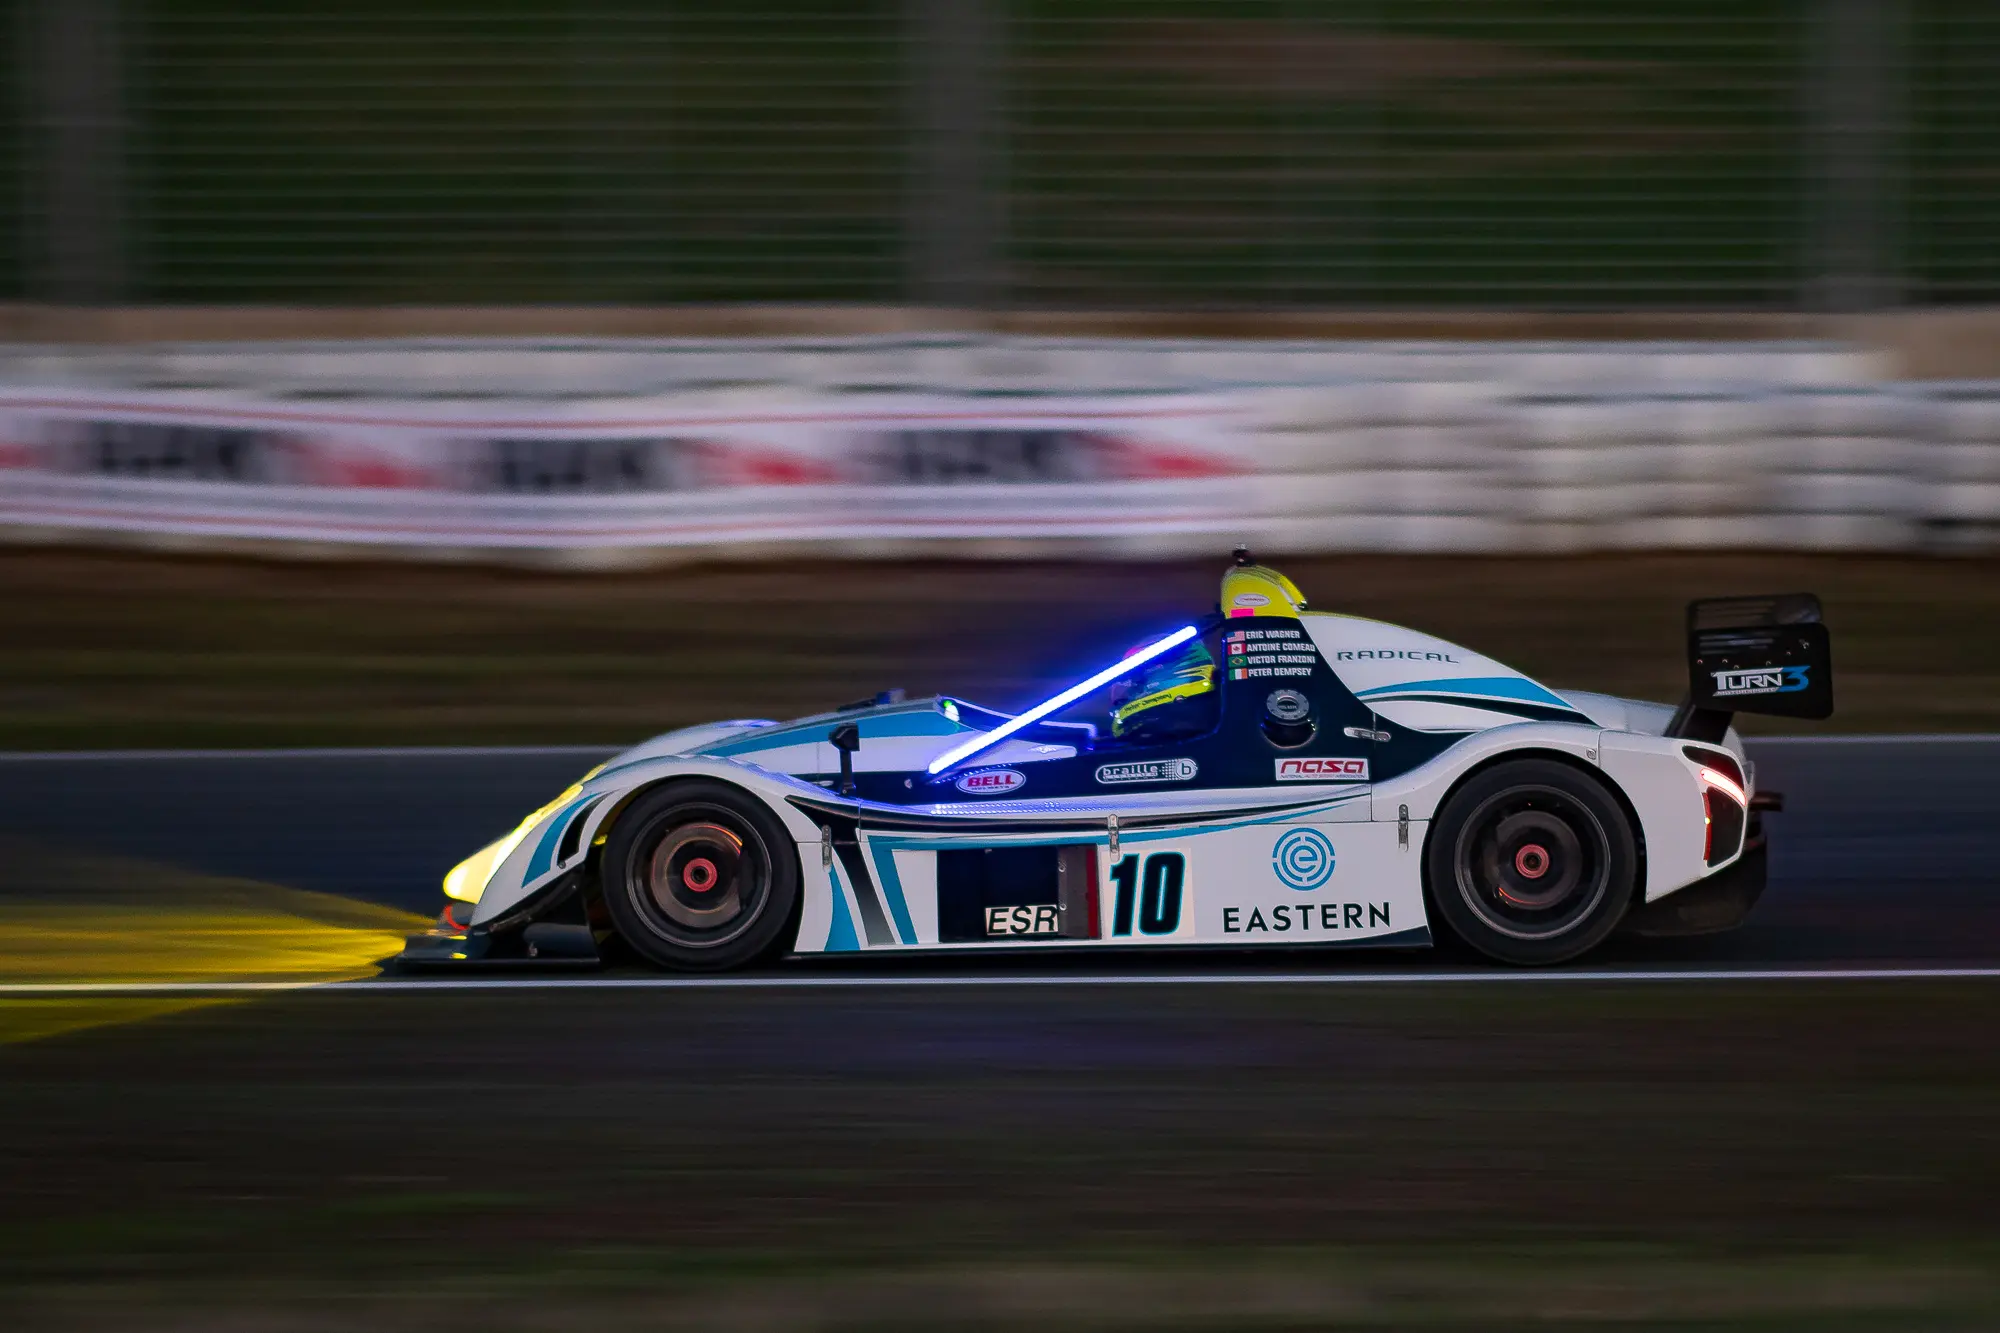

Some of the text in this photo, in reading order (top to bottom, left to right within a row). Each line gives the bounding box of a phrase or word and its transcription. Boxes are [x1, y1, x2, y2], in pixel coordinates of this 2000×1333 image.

[1246, 630, 1300, 639] ERIC WAGNER
[1247, 643, 1281, 652] ANTOINE
[1247, 655, 1316, 665] VICTOR FRANZONI
[1337, 650, 1459, 664] RADICAL
[1248, 667, 1312, 677] PETER DEMPSEY
[1103, 764, 1158, 776] braille
[967, 774, 1016, 787] BELL
[1109, 851, 1187, 937] 10
[988, 906, 1058, 934] ESR
[1222, 902, 1391, 933] EASTERN
